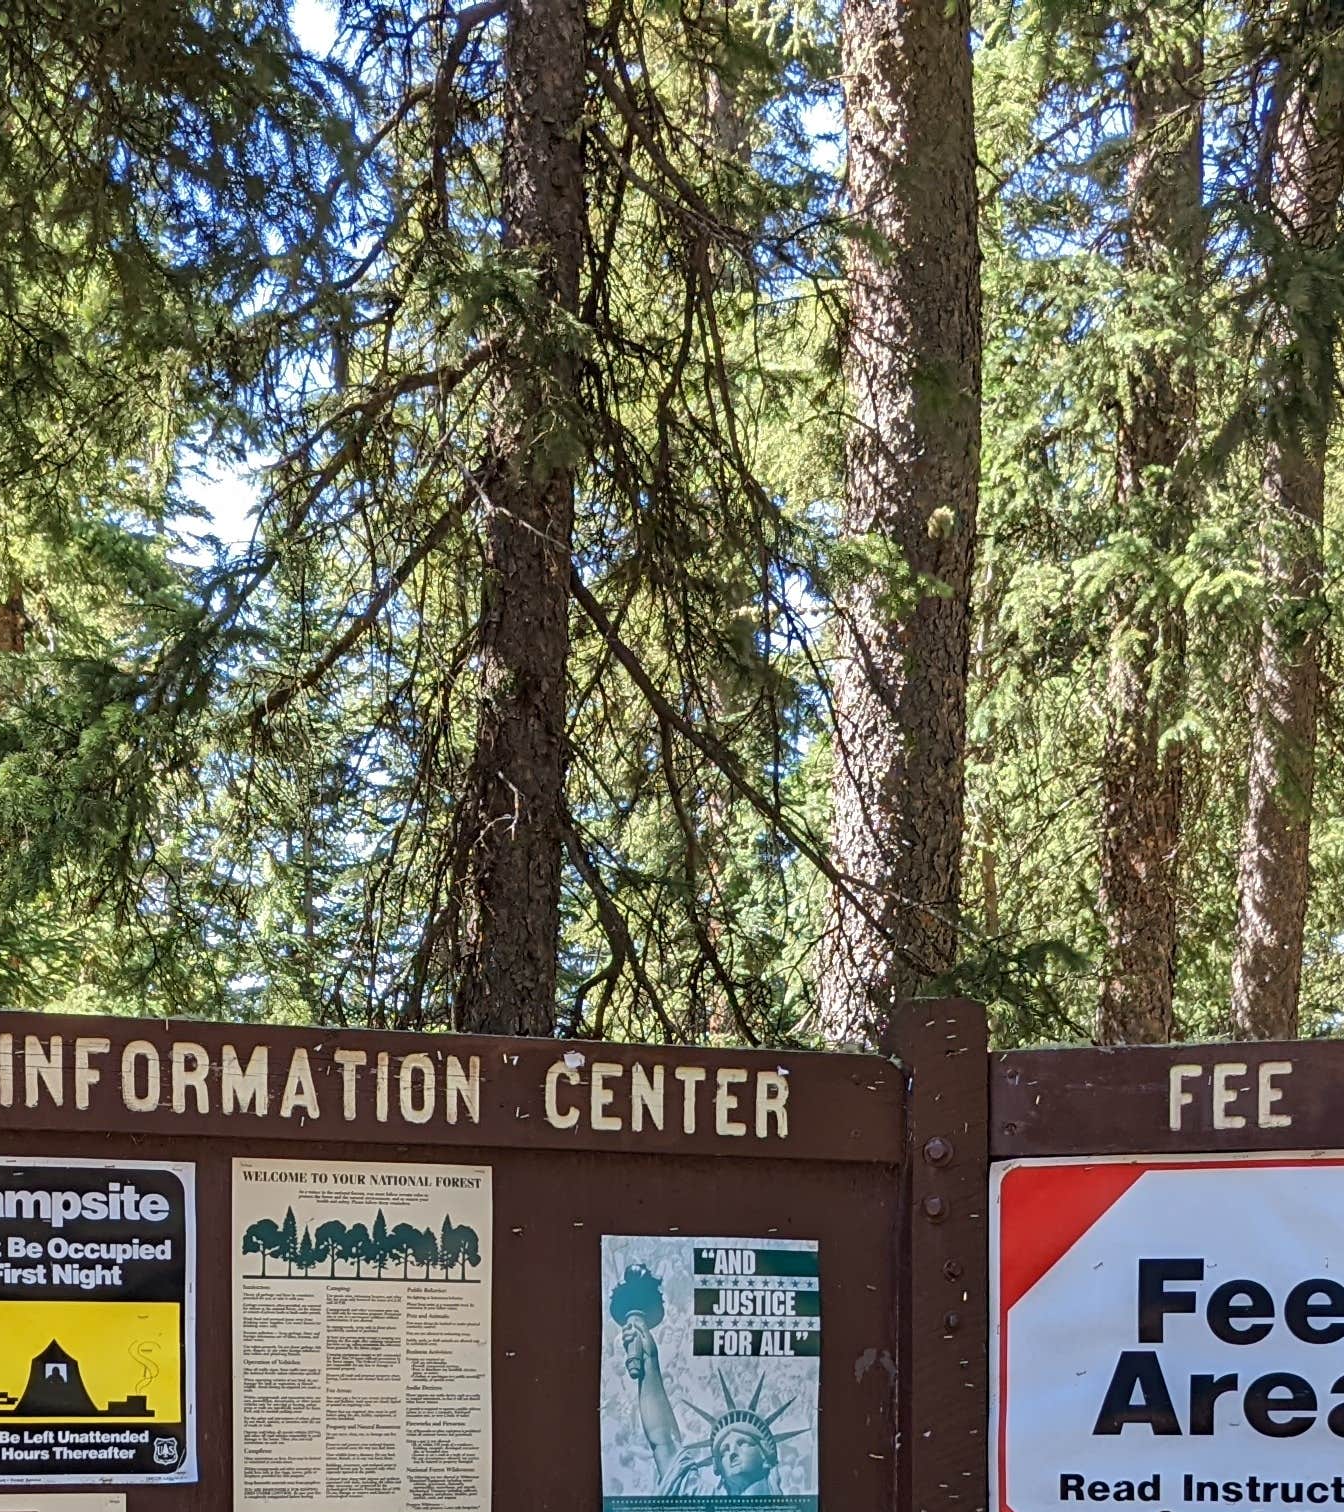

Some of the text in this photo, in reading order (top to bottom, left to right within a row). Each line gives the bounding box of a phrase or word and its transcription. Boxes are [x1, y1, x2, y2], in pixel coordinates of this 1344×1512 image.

[544, 1051, 789, 1139] CENTER
[1168, 1062, 1294, 1131] FEE
[243, 1171, 481, 1189] WELCOME TO YOUR NATIONAL FOREST
[8, 1237, 43, 1258] Be
[48, 1238, 171, 1263] Occupied
[52, 1264, 122, 1289] Night
[713, 1291, 796, 1316] JUSTICE
[713, 1331, 752, 1355] FOR
[24, 1431, 54, 1443] Left
[57, 1431, 149, 1444] Unattended
[1, 1448, 49, 1460] Hours
[52, 1447, 135, 1460] Thereafter
[1059, 1473, 1161, 1502] Read
